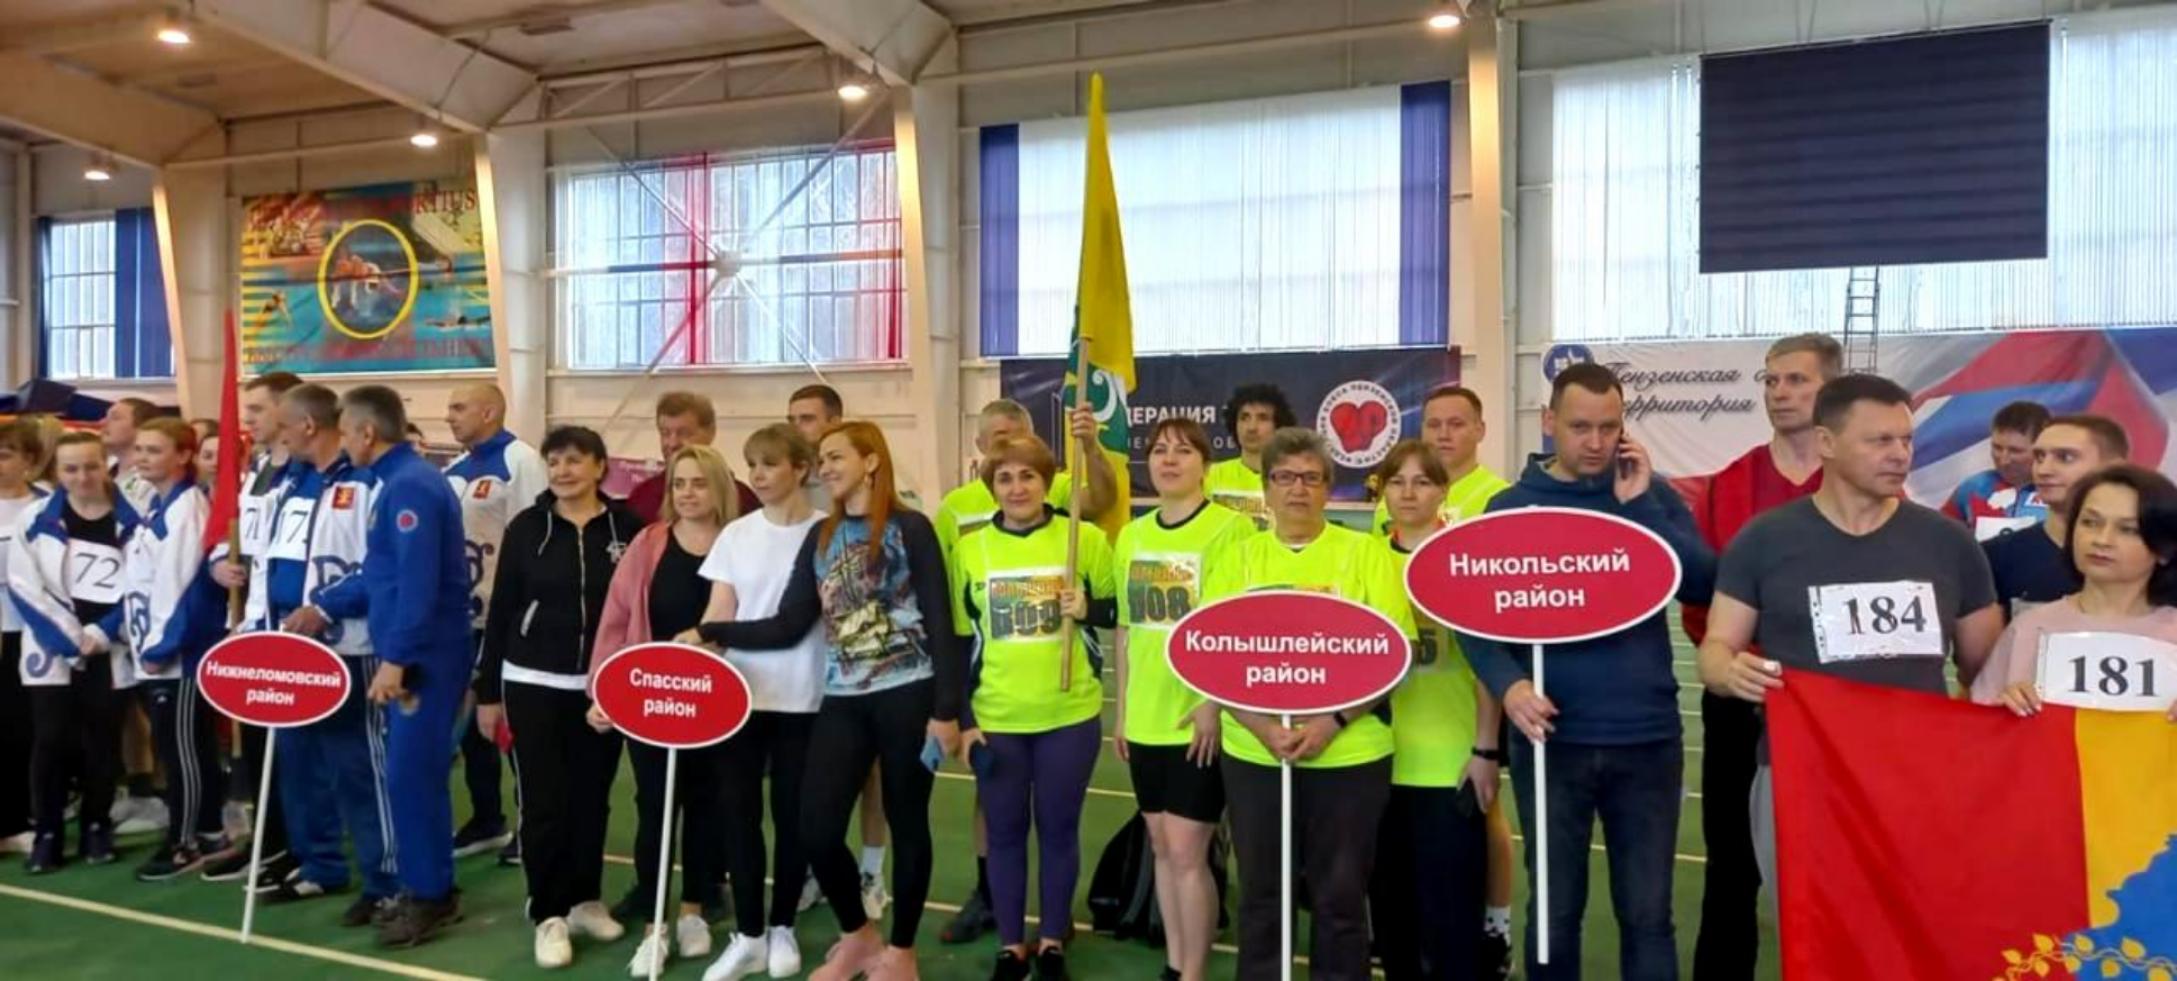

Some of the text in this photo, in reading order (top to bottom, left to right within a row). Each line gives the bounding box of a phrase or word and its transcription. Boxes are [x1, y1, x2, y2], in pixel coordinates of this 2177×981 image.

[1127, 405, 1216, 424] ЕРАЦИЯ
[1623, 394, 1757, 421] ерритория
[285, 510, 309, 544] 7
[74, 552, 121, 589] 72
[1449, 548, 1630, 576] Никольский
[1495, 584, 1585, 613] район
[1846, 596, 1926, 635] 184
[1185, 630, 1389, 655] Колышлейский
[206, 661, 341, 689] Нижнеломовский
[630, 668, 712, 693] Спасский
[1245, 661, 1326, 685] район
[2068, 655, 2159, 697] 181
[246, 688, 295, 705] район
[643, 697, 696, 718] район
